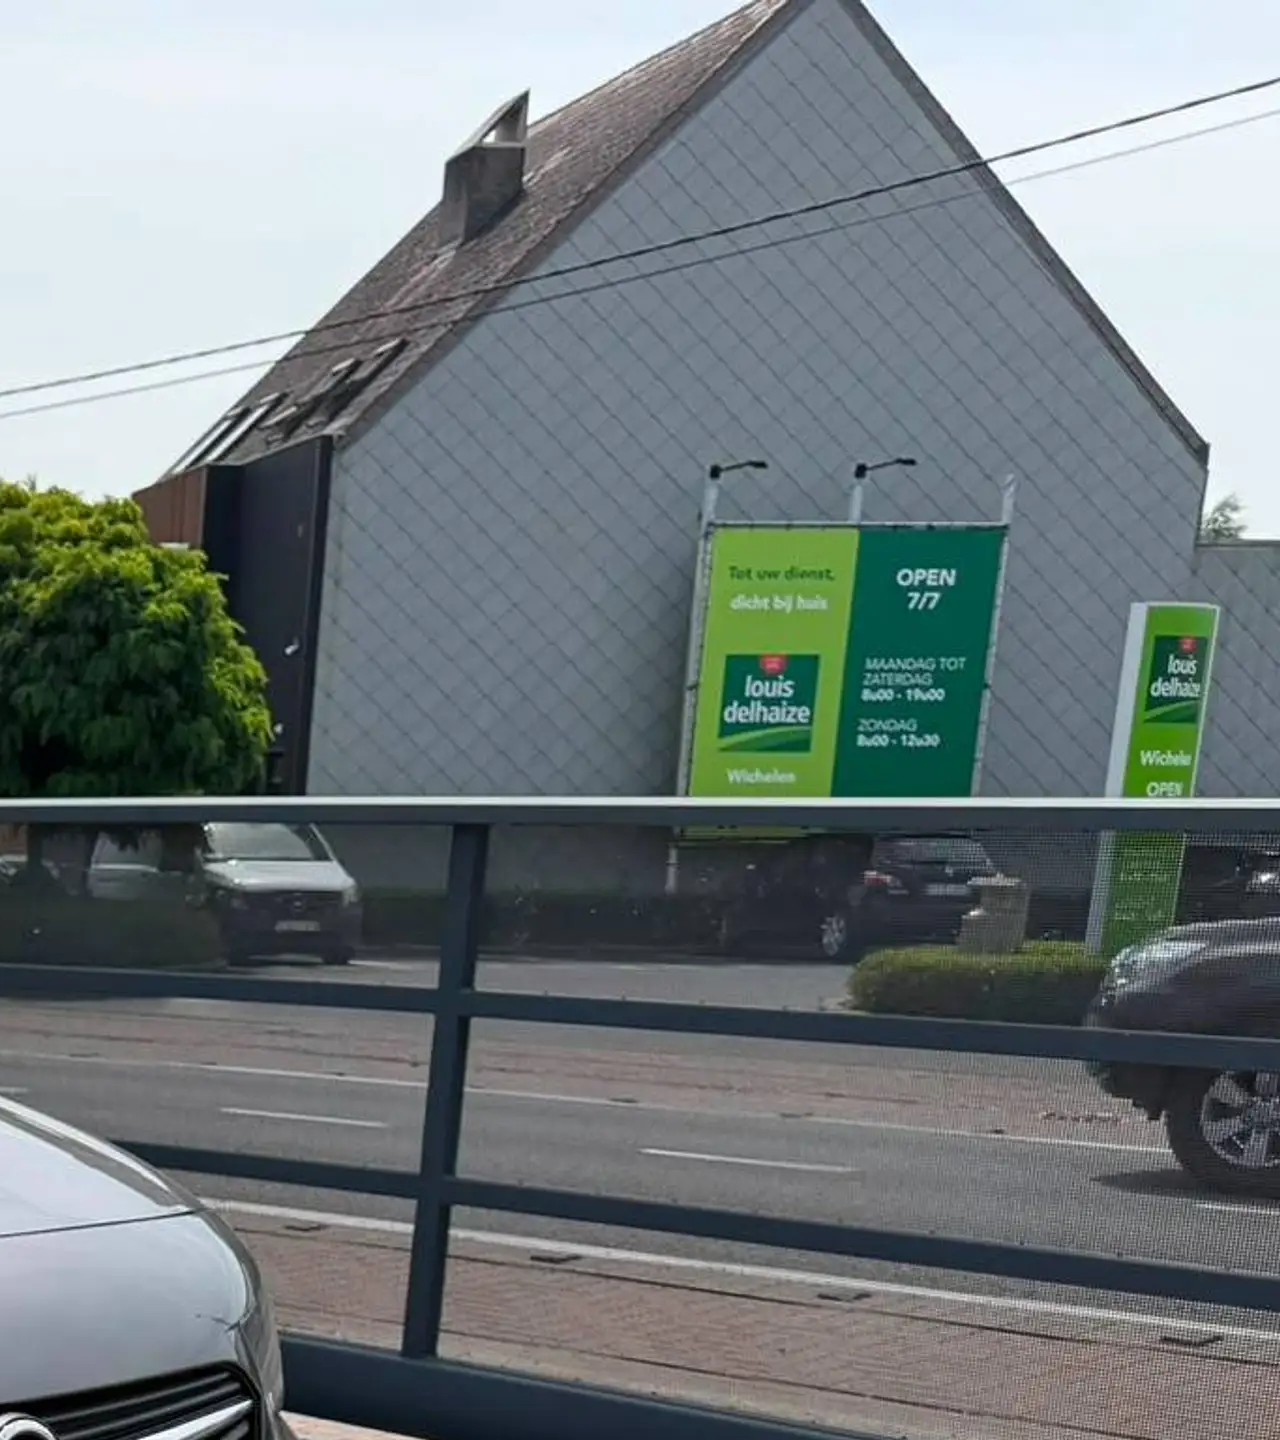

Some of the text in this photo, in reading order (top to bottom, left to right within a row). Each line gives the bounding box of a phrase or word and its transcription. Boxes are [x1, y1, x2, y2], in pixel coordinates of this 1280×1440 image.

[728, 565, 752, 581] Tot
[756, 569, 781, 581] uw
[896, 569, 957, 587] OPEN
[729, 594, 828, 614] dicht bij huis
[906, 592, 942, 610] 7/7
[865, 657, 966, 671] MAANDAG TOT
[1167, 654, 1198, 675] louis
[744, 675, 795, 698] louis
[862, 672, 933, 686] ZATERDAG
[724, 700, 811, 724] delhaize
[857, 718, 918, 732] ZONDAG
[727, 768, 796, 784] Wichelen
[1146, 781, 1184, 797] OPEN
